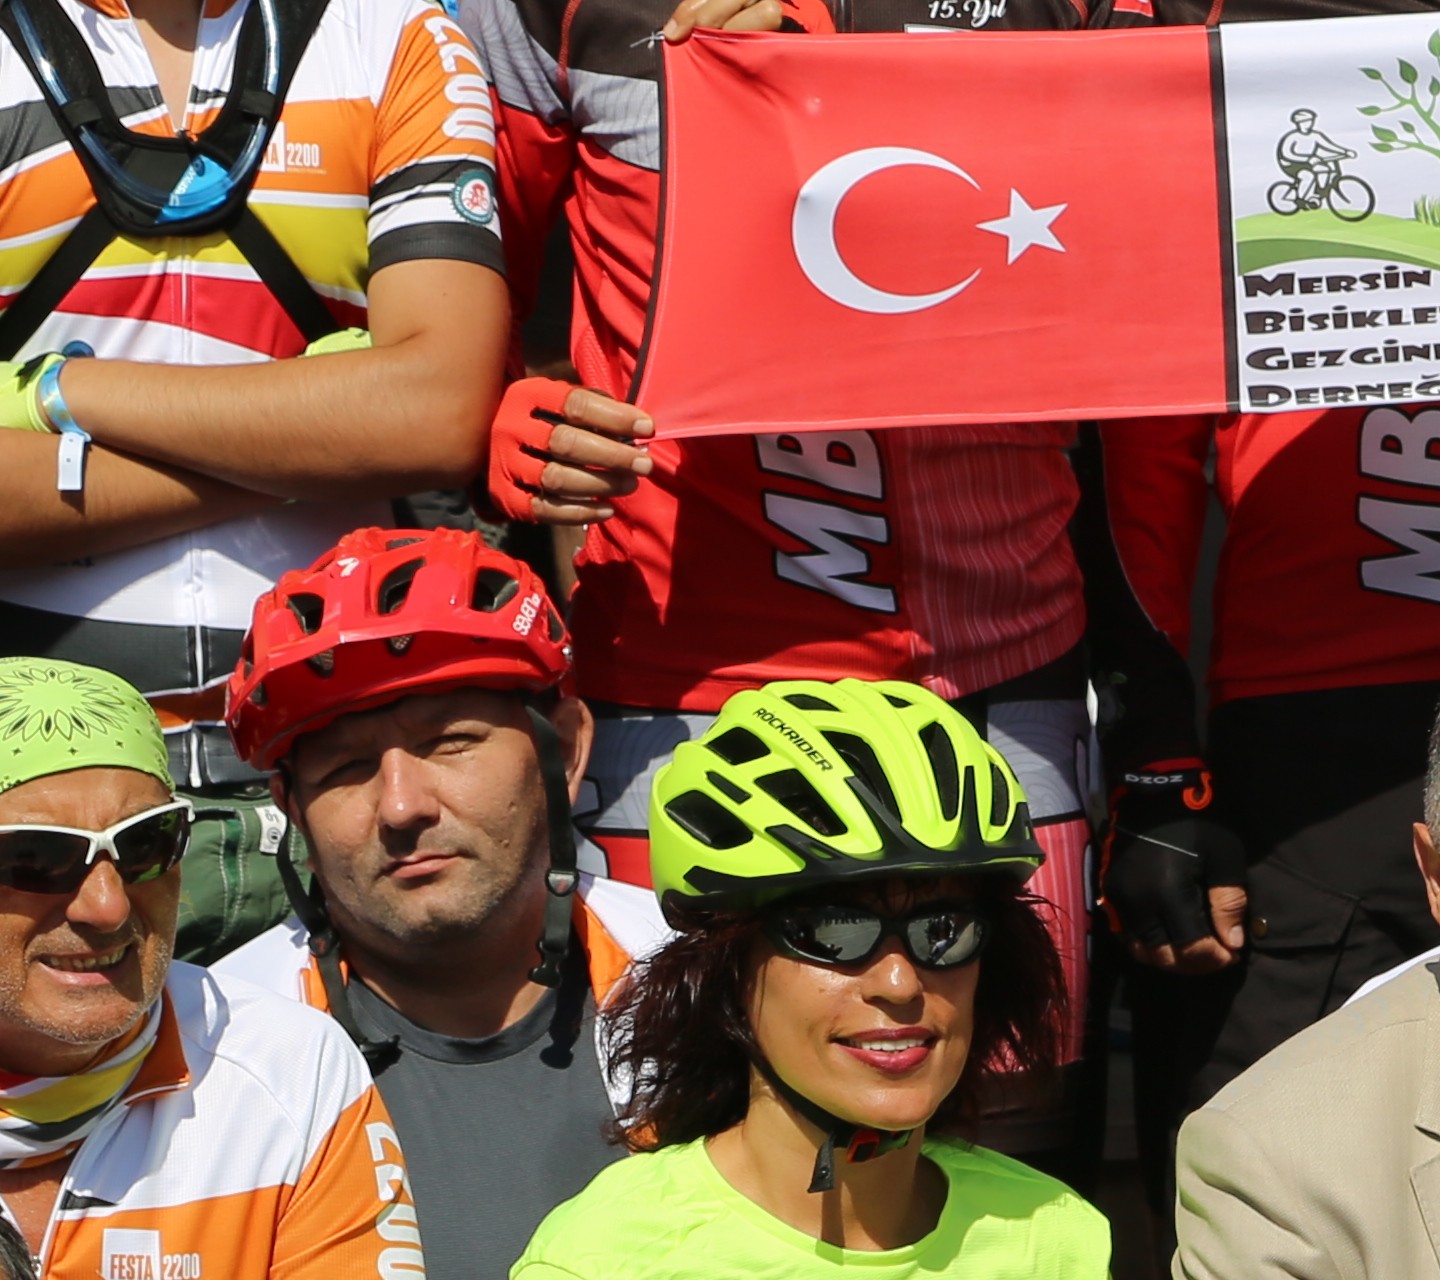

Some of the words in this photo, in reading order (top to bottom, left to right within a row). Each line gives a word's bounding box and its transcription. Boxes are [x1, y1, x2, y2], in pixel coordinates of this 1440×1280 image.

[419, 15, 499, 147] 2200
[285, 142, 322, 170] 2200
[754, 428, 900, 614] MB
[752, 707, 835, 773] ROCKRIDER
